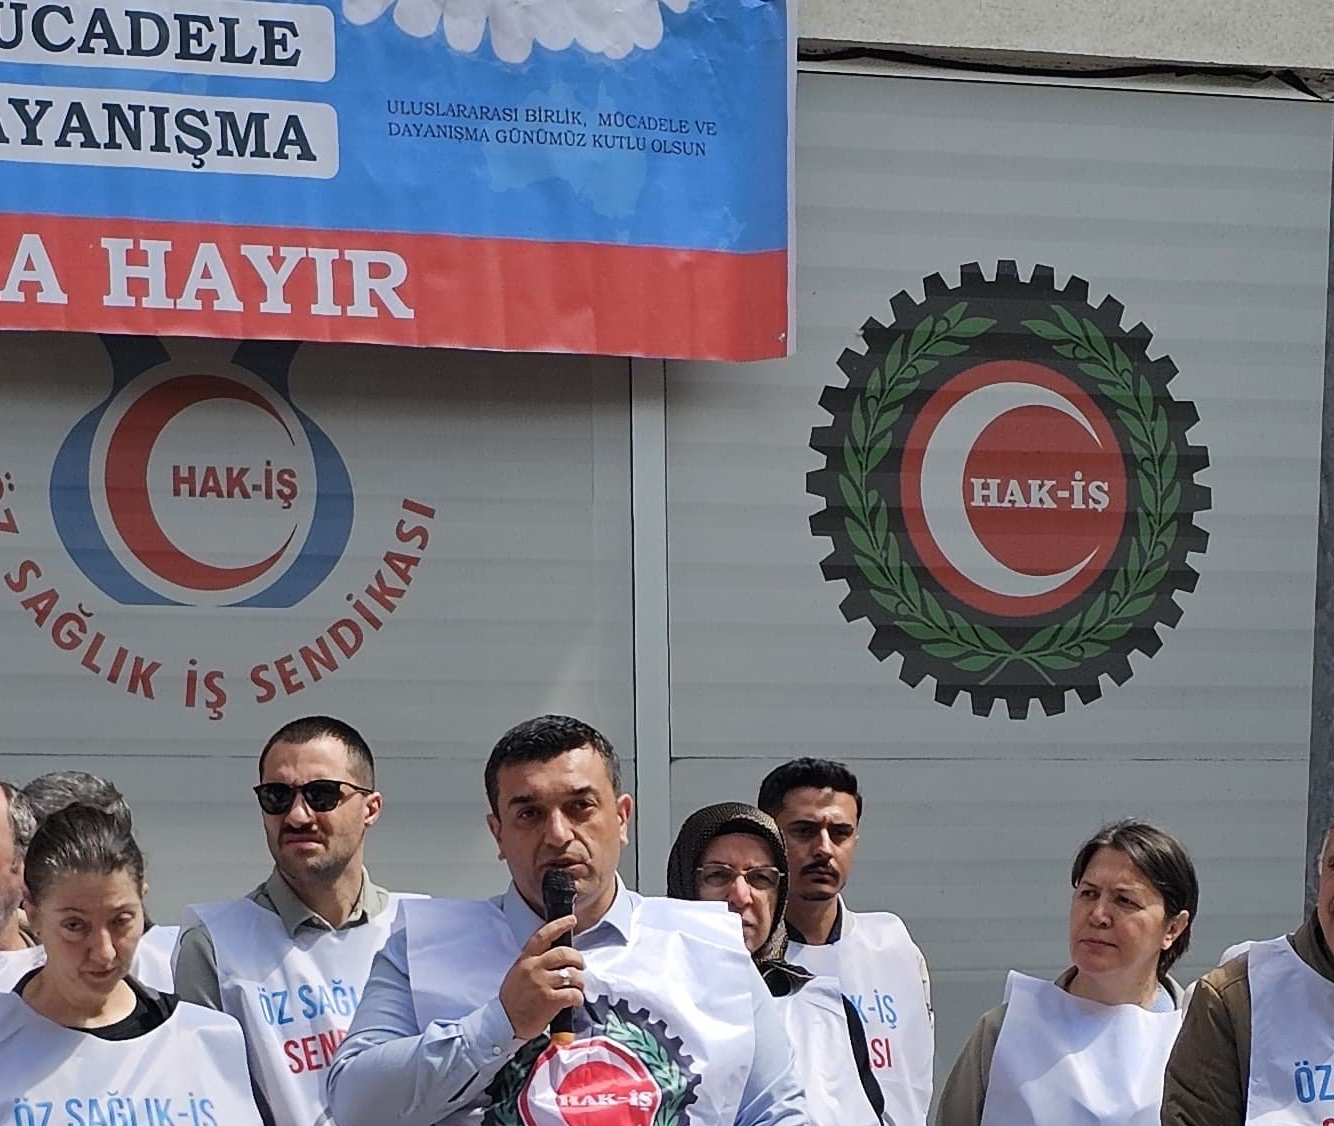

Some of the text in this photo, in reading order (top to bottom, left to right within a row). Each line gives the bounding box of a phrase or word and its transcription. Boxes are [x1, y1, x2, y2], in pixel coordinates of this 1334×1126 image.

[387, 100, 518, 121] ULUSLARARASI
[598, 111, 689, 134] MÜCADELE
[695, 119, 717, 136] VE
[388, 121, 706, 156] DAYANIŞMA GÜNÜMÜZ KUTLU OLSUN
[99, 236, 414, 320] HAYIR
[171, 459, 299, 509] HAK-İŞ
[970, 471, 1110, 512] HAK-İŞ
[4, 558, 162, 700] SAĞLIK
[185, 658, 227, 720] İŞ
[250, 498, 437, 704] SENDİKASI
